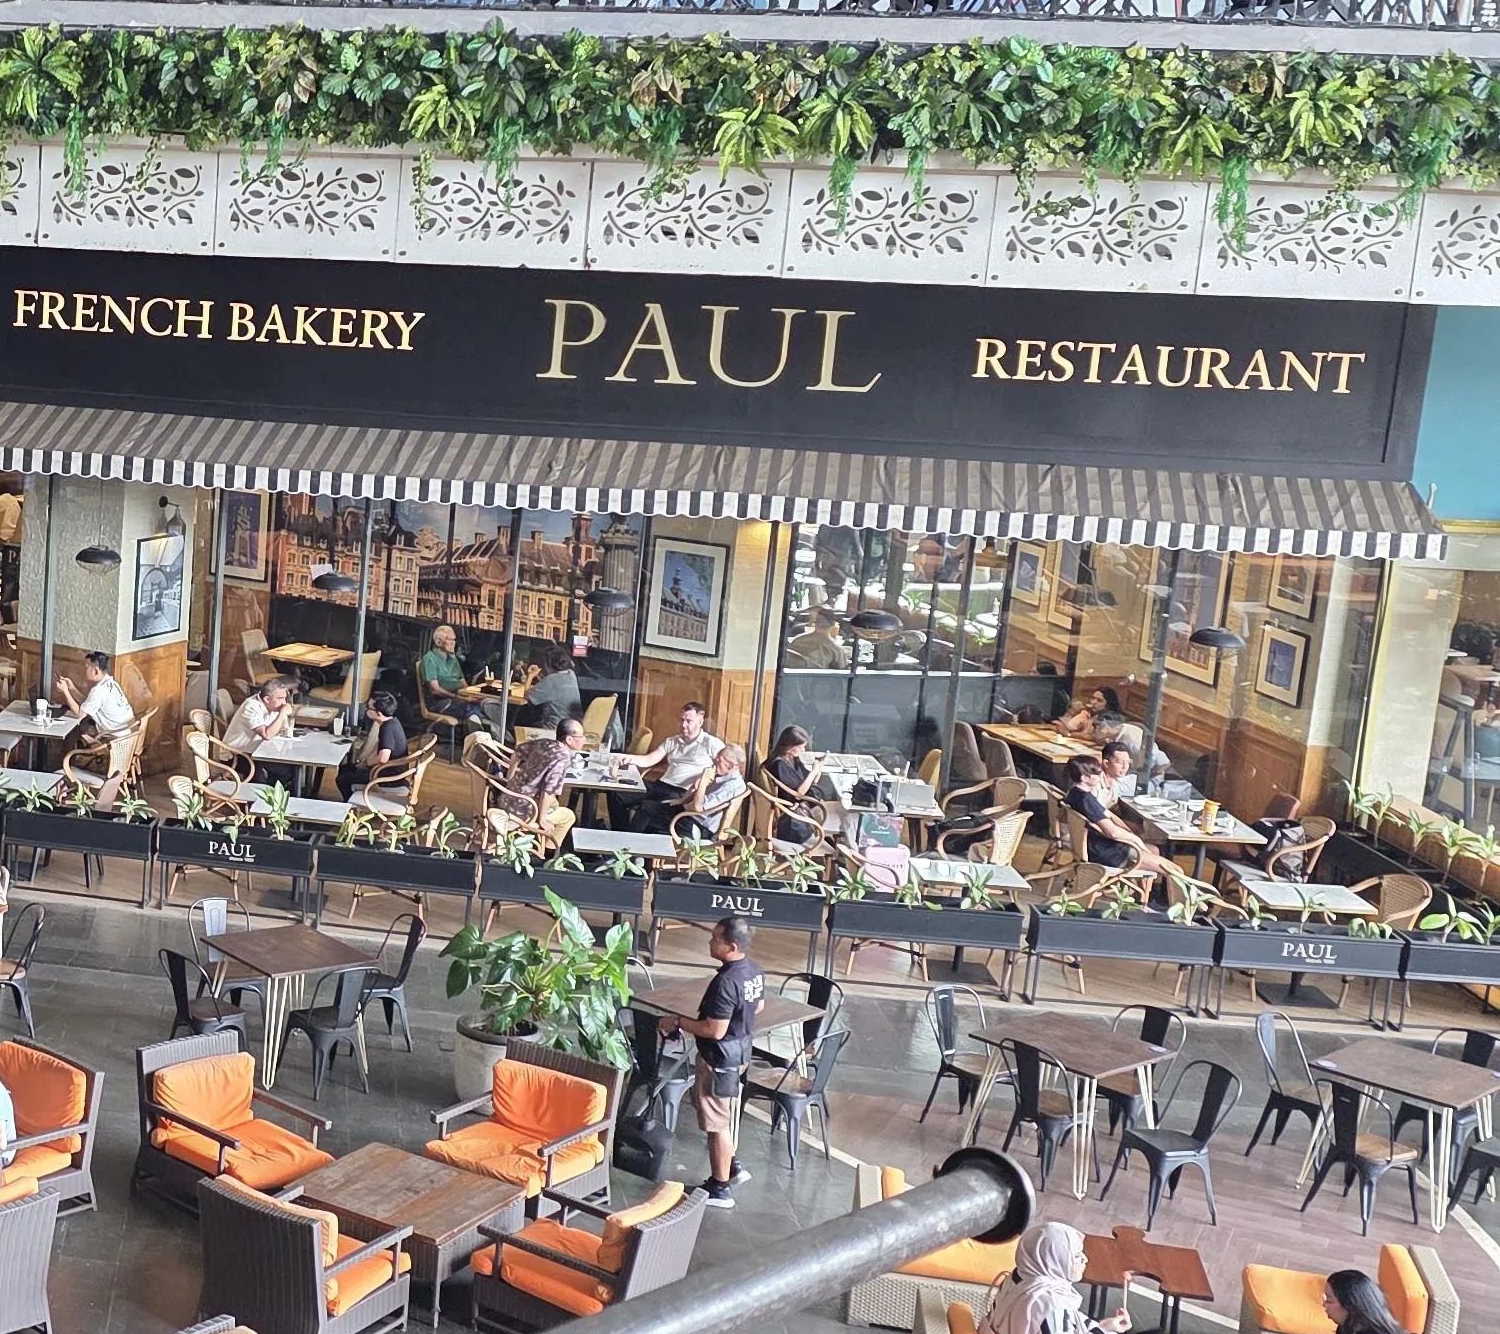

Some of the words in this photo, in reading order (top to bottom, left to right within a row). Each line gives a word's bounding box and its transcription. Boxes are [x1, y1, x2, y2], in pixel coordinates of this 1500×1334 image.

[13, 290, 212, 340] FRENCH
[227, 302, 425, 353] BAKERY
[536, 299, 881, 393] PAUL
[972, 338, 1365, 395] RESTAURANT
[208, 840, 256, 858] PAUL
[711, 894, 765, 912] PAUL
[1281, 942, 1338, 959] PAUL
